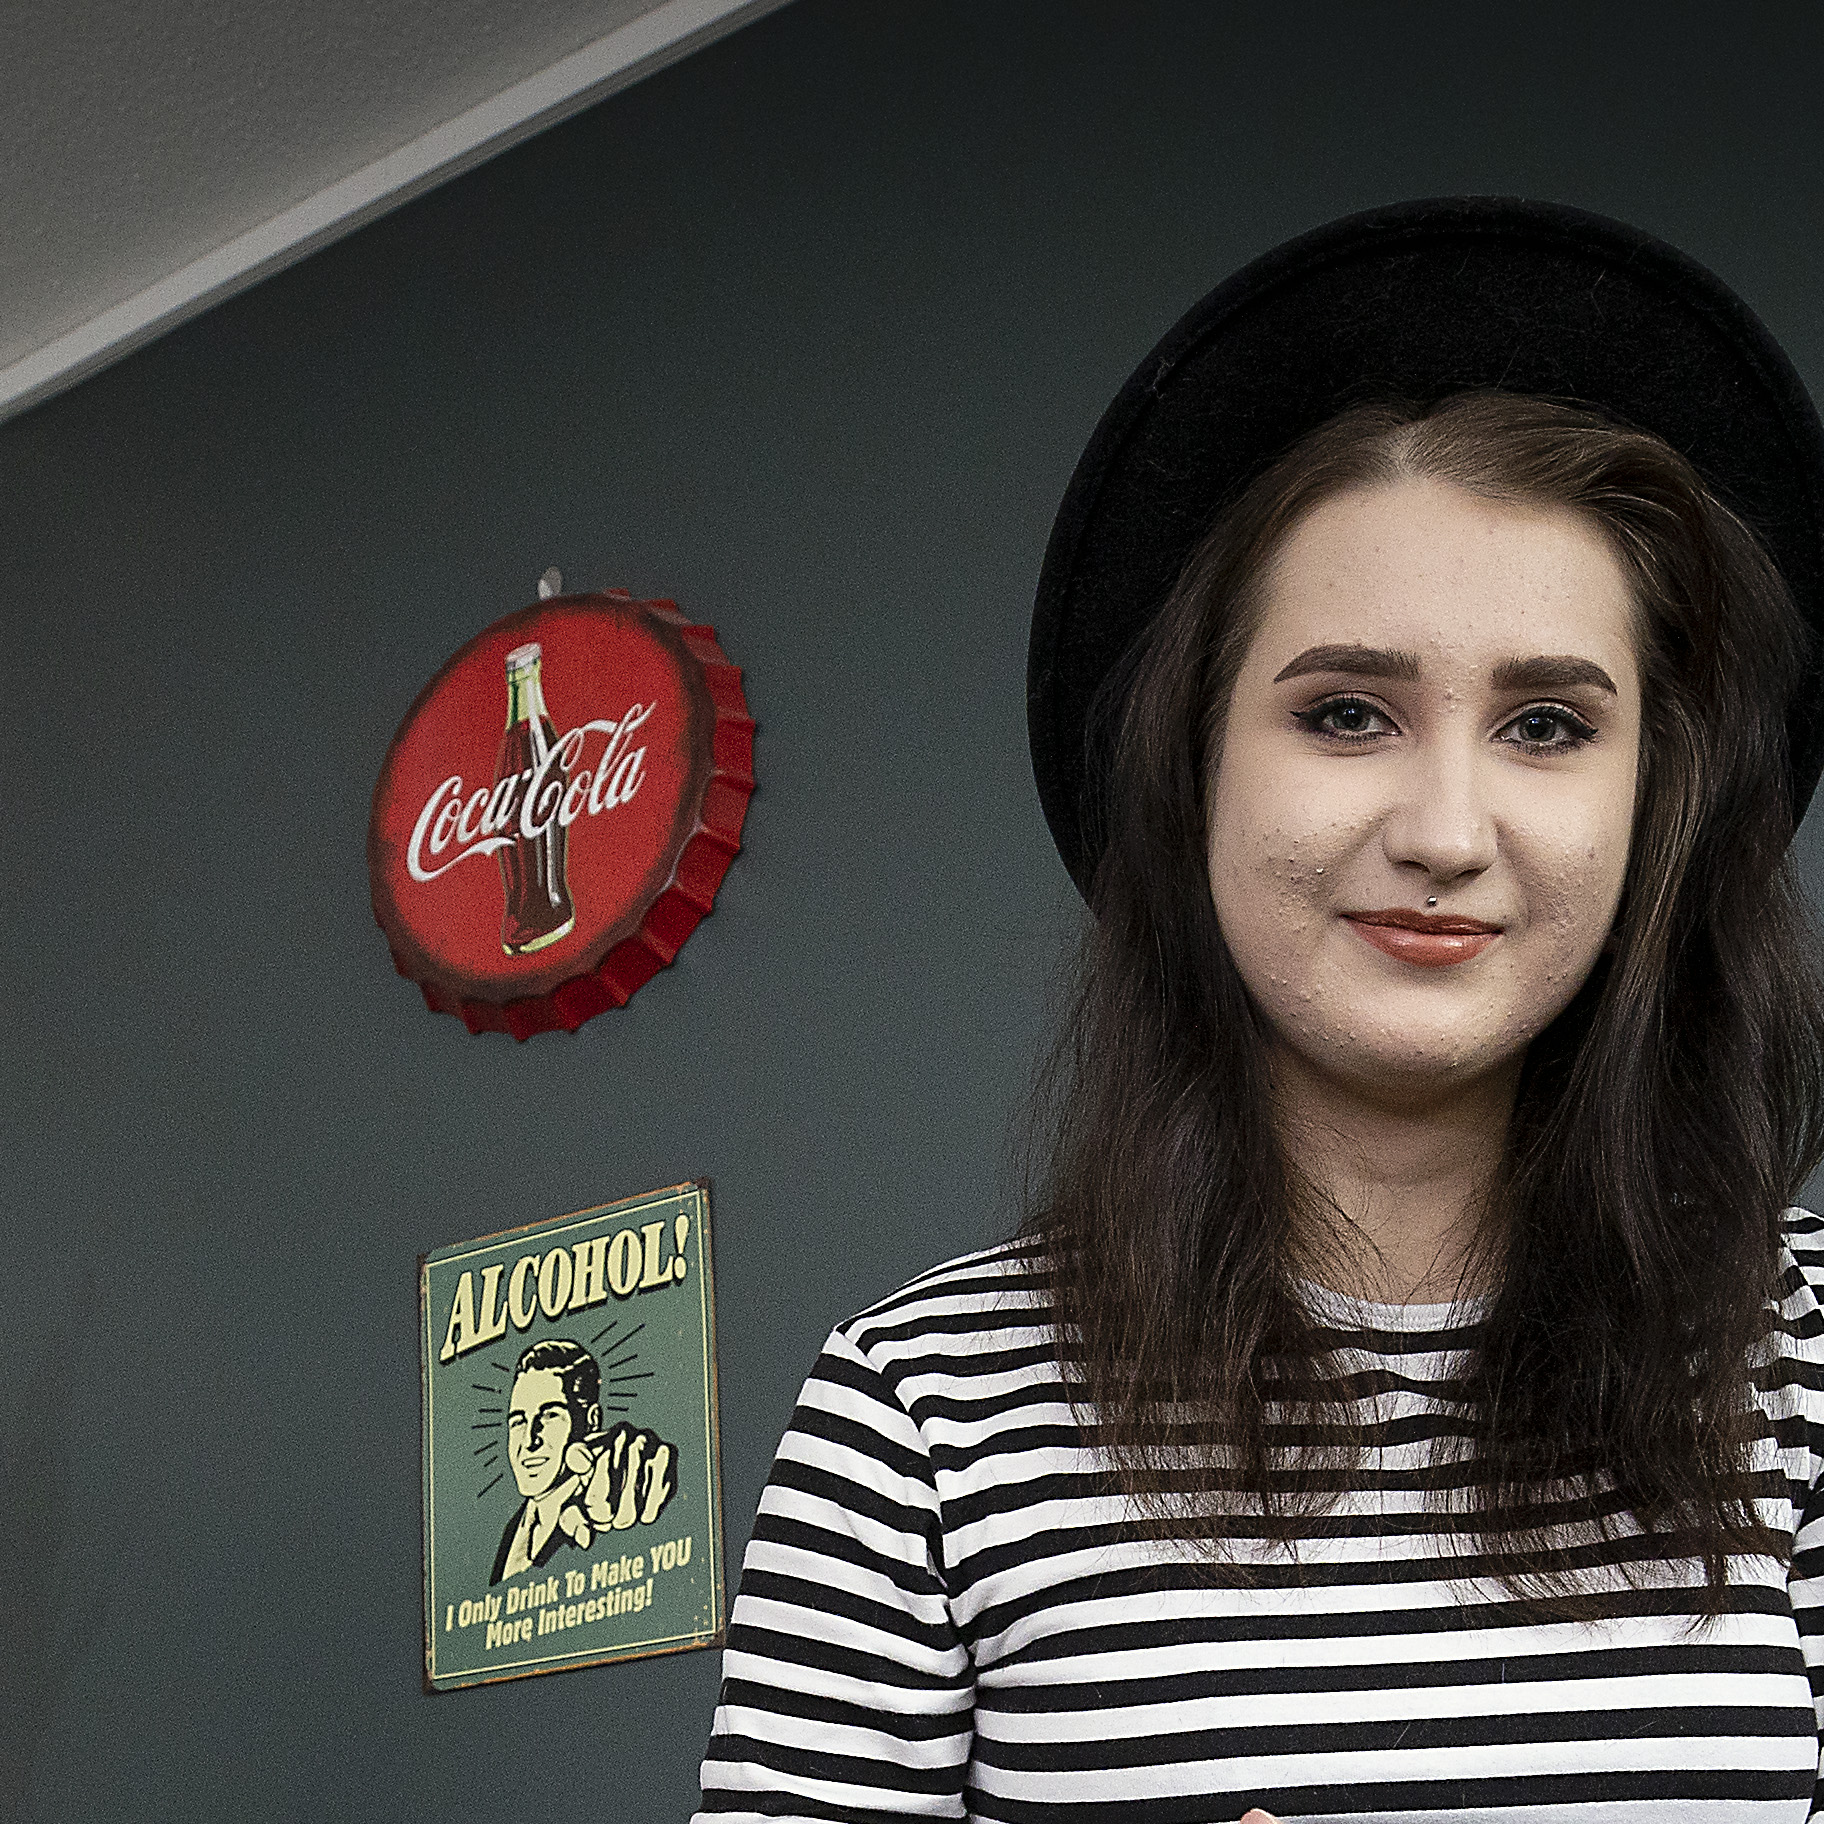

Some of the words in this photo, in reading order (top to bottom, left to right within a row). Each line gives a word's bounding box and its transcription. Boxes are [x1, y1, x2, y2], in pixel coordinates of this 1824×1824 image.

[406, 700, 658, 882] Coca-Cola
[439, 1212, 691, 1362] ALCOHOL!
[445, 1605, 454, 1632] I
[458, 1593, 503, 1628] Only
[506, 1576, 560, 1615] Drink
[565, 1569, 586, 1598] To
[590, 1555, 645, 1591] Make
[650, 1537, 693, 1574] YOU
[485, 1616, 534, 1651] More
[537, 1577, 654, 1636] Interesting!
